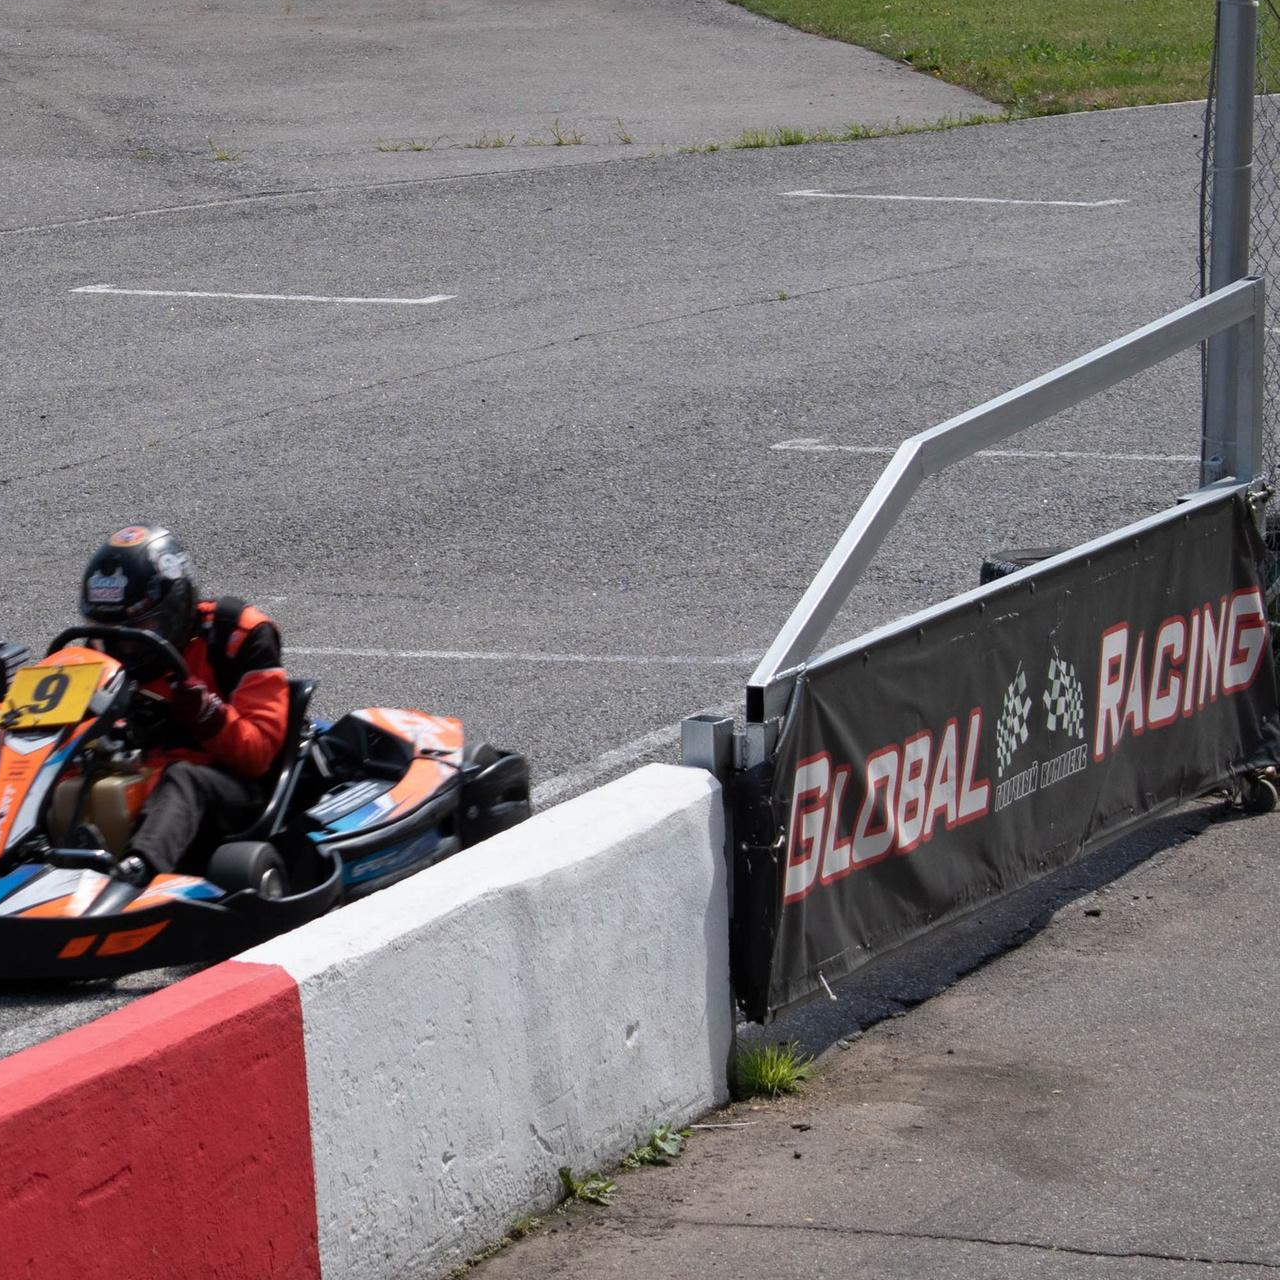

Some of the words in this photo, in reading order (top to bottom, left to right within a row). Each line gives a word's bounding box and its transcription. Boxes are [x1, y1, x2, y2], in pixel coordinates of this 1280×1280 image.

[28, 673, 70, 715] 9
[784, 706, 991, 904] GLOBAL
[1093, 586, 1269, 762] RACING
